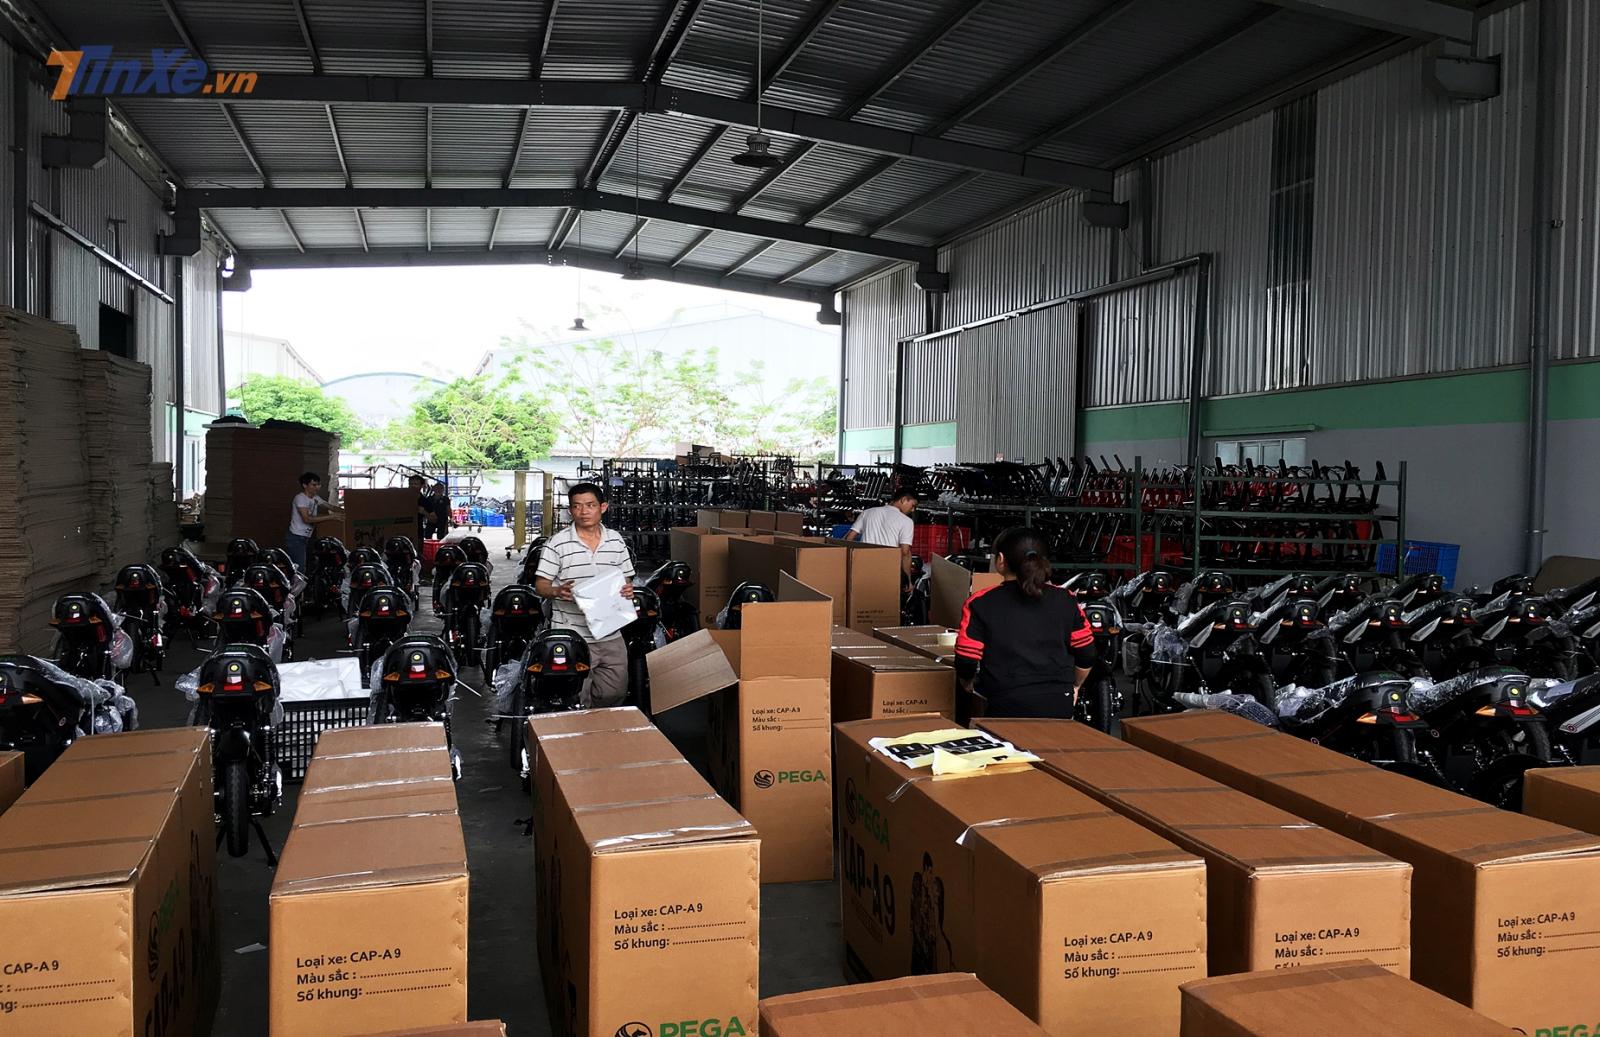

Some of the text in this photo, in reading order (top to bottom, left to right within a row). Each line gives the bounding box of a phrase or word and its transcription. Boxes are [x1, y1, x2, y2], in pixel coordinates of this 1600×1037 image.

[752, 708, 766, 716] Loại
[778, 769, 826, 784] PEGA
[857, 793, 891, 852] PEGA
[614, 908, 638, 920] Loại
[641, 908, 657, 918] xe:
[1498, 915, 1518, 928] Loại
[1521, 917, 1535, 925] xe:
[614, 924, 638, 935] Màu
[1064, 935, 1088, 948] Loại
[1090, 936, 1107, 945] xe:
[1275, 931, 1298, 944] Loại
[1300, 932, 1316, 941] xe:
[1497, 931, 1518, 942] Màu
[614, 938, 670, 950] Số khung:
[1064, 951, 1088, 963] Màu
[1275, 947, 1298, 959] Màu
[1497, 946, 1546, 957] Số khung:
[296, 955, 324, 968] Loại
[328, 956, 347, 965] xe:
[296, 972, 325, 985] Màu
[1064, 966, 1120, 979] Số khung:
[296, 987, 363, 1002] Số khung:
